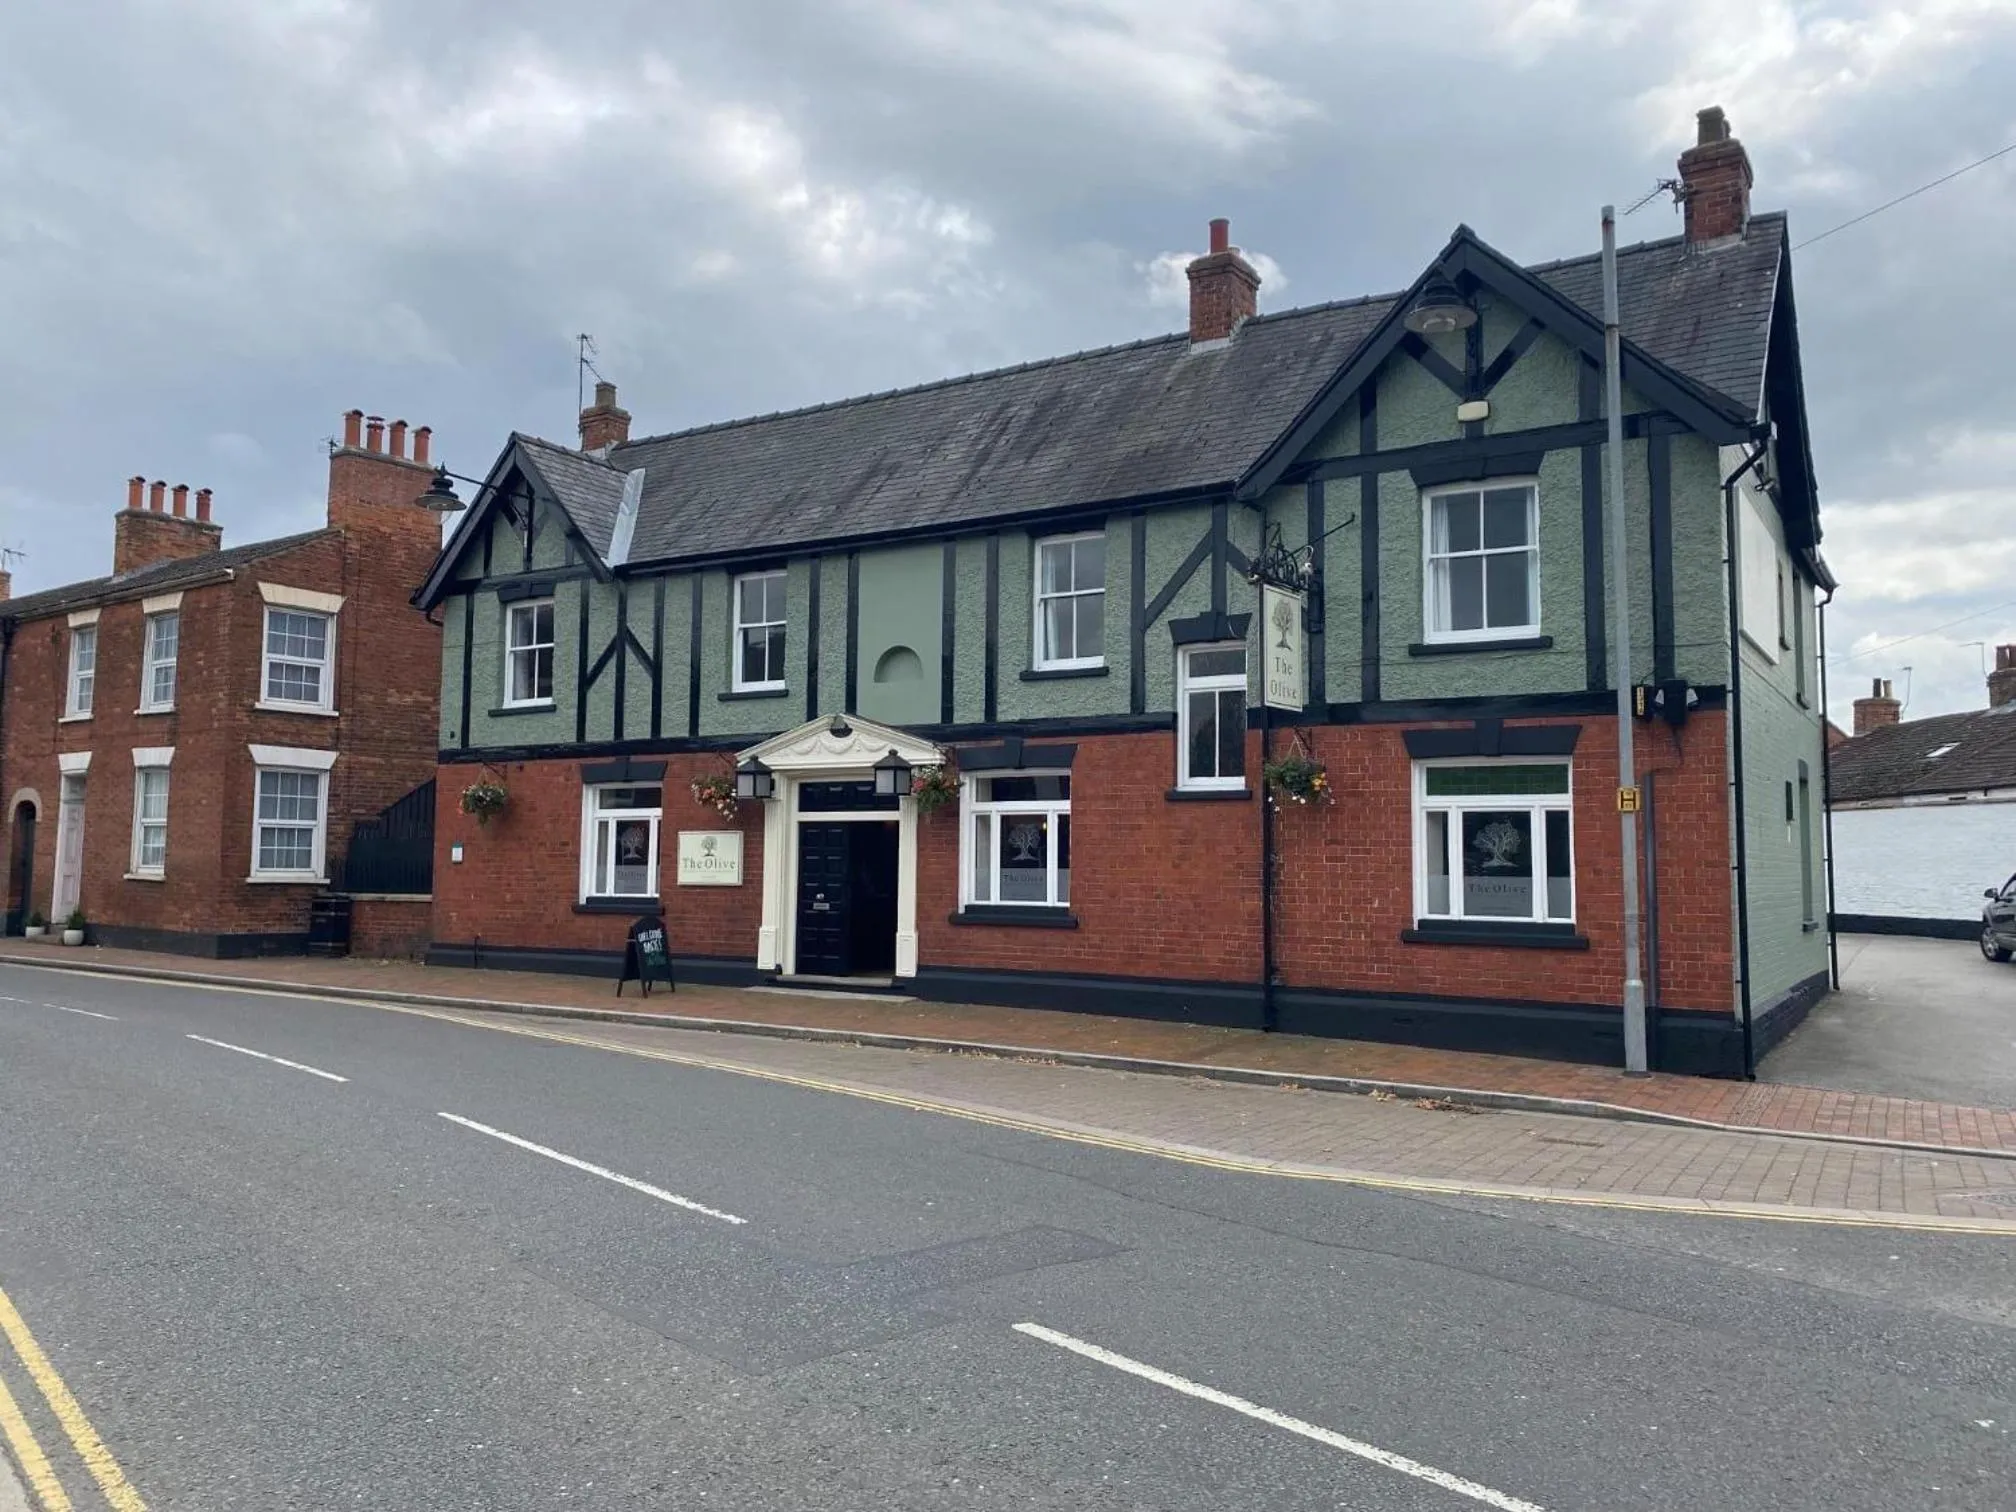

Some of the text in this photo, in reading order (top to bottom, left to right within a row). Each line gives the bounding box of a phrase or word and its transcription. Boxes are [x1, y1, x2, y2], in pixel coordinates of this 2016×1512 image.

[1273, 656, 1294, 675] The
[1270, 679, 1298, 699] Olive
[1620, 790, 1637, 809] H
[683, 856, 736, 869] The Olive
